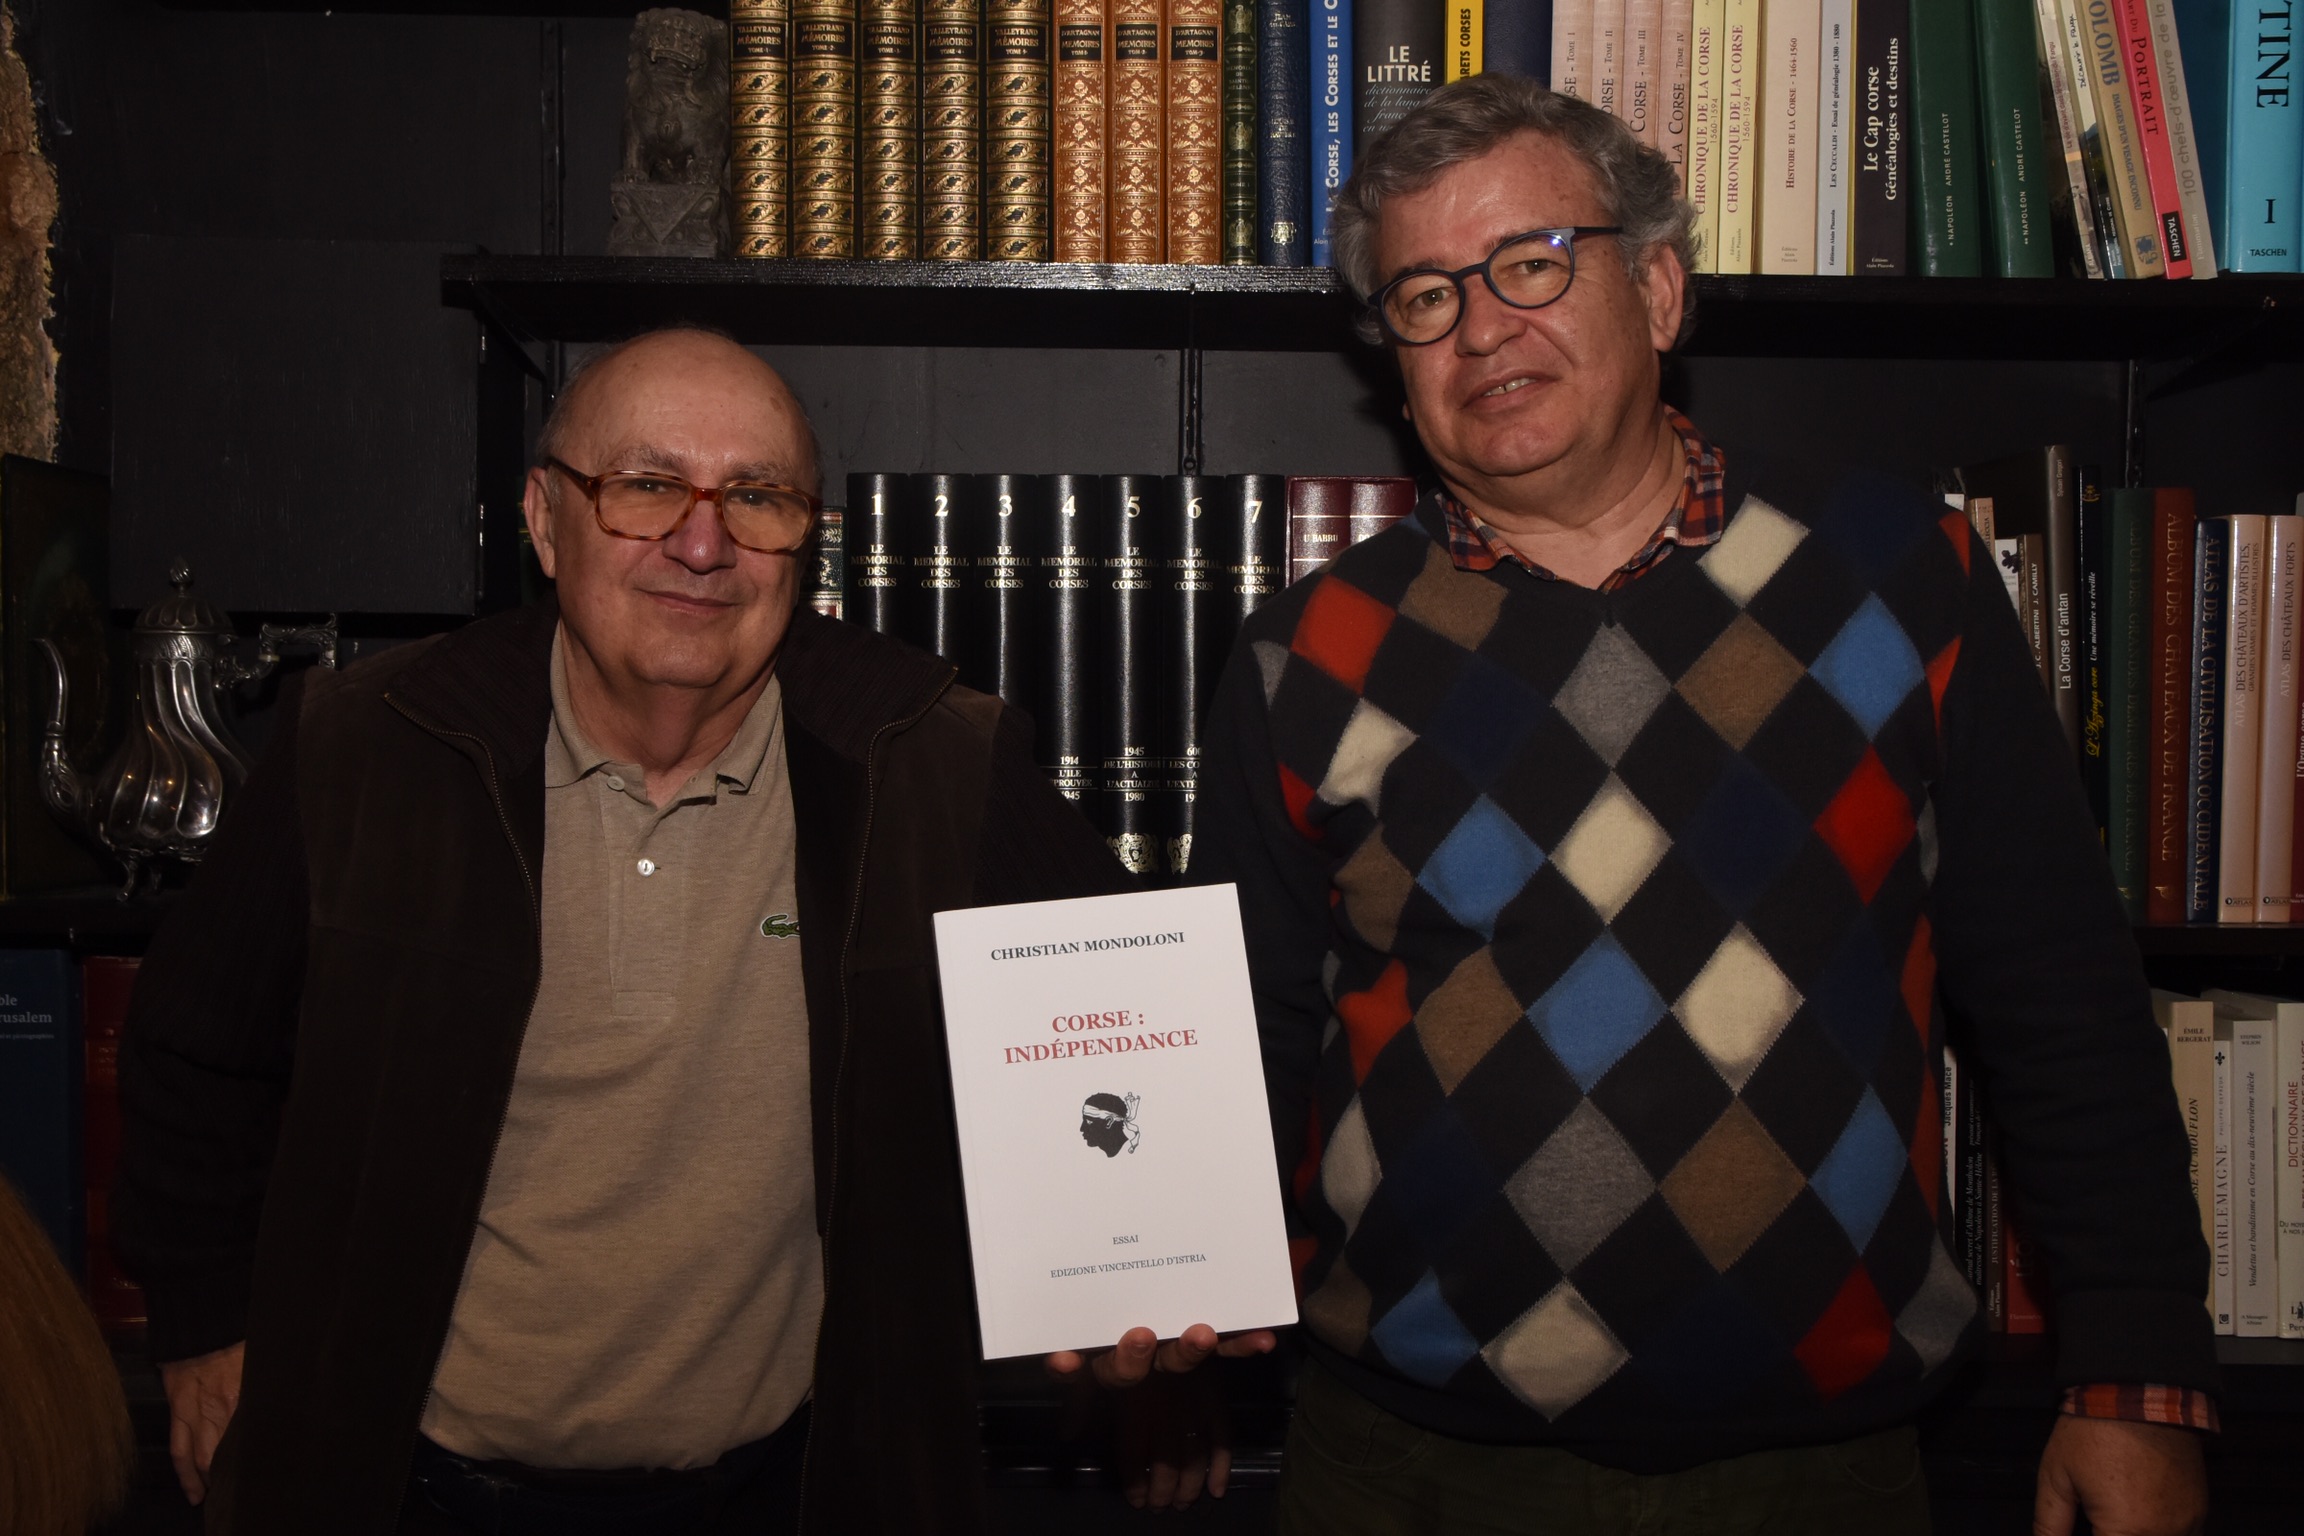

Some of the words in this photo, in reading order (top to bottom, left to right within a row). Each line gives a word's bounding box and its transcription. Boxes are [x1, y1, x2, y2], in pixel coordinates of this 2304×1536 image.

[1328, 16, 1338, 28] LE
[2155, 4, 2166, 18] la
[737, 26, 780, 34] TALLEYRAND
[802, 24, 844, 32] TALLEYRAND
[802, 33, 845, 43] MÉMOIRES
[930, 27, 972, 35] TALLEYRAND
[995, 27, 1038, 35] TALLEYRAND
[1460, 8, 1471, 47] CORSES
[2159, 24, 2170, 43] de
[737, 35, 781, 45] MÉMOIRES
[929, 36, 973, 46] MÉMOIRES
[995, 36, 1038, 46] MÉMOIRES
[1328, 35, 1338, 48] ET
[1731, 25, 1743, 74] CORSE
[2089, 0, 2120, 86] OLOMB
[1390, 46, 1410, 62] LE
[1698, 27, 1710, 76] CORSE
[2255, 0, 2293, 108] TINE
[1368, 60, 1431, 82] LITTRÉ
[1886, 38, 1898, 90] destins
[1325, 54, 1338, 106] CORSES
[1366, 84, 1431, 95] dictionnaire
[1668, 83, 1684, 134] CORSE
[1677, 32, 1684, 41] IV
[1698, 80, 1708, 99] LA
[1731, 78, 1741, 97] LA
[1832, 64, 1840, 99] généalogie
[1868, 66, 1879, 111] corse
[2132, 37, 2158, 135] PORTRAIT
[1364, 96, 1377, 108] de
[1380, 96, 1391, 107] la
[1630, 81, 1647, 132] CORSE
[1730, 101, 1741, 120] DE
[1787, 88, 1796, 117] CORSE
[1832, 101, 1838, 109] de
[1888, 94, 1897, 108] et
[2164, 49, 2189, 164] chefs-d'œuvre
[1328, 112, 1338, 132] LES
[1697, 103, 1708, 122] DE
[1710, 98, 1718, 143] 1560-1594
[1743, 96, 1751, 141] 1560-1594
[1789, 120, 1795, 130] LA
[1864, 116, 1883, 148] Cap
[1942, 113, 1950, 155] CASTELOT
[2014, 108, 2023, 151] CASTELOT
[1789, 133, 1795, 144] DE
[1325, 139, 1340, 188] CORSE,
[1864, 152, 1878, 171] Le
[1885, 112, 1900, 200] Généalogies
[1695, 126, 1709, 214] CHRONIQUE
[1727, 124, 1742, 213] CHRONIQUE
[1786, 148, 1795, 188] HISTOIRE
[2016, 154, 2024, 182] ANDRÉ
[2181, 169, 2196, 196] 100
[1946, 195, 1954, 240] NAPOLÉON
[2020, 191, 2029, 236] NAPOLÉON
[2264, 198, 2276, 224] I
[2168, 217, 2181, 257] TASCHEN
[2250, 248, 2287, 257] TASCHEN
[872, 493, 884, 515] 1
[935, 495, 949, 516] 2
[999, 495, 1012, 516] 3
[1062, 496, 1076, 517] 4
[1127, 496, 1140, 518] 5
[1187, 497, 1202, 519] 6
[1247, 500, 1263, 523] 7
[870, 544, 884, 554] LE
[1312, 534, 1338, 543] BABBU
[2167, 512, 2184, 582] ALBUM
[851, 556, 905, 565] MEMORIAL
[914, 557, 969, 566] MEMORIAL
[934, 546, 948, 555] LE
[977, 557, 1032, 566] MEMORIAL
[997, 546, 1011, 555] LE
[1062, 546, 1076, 555] LE
[1126, 547, 1139, 556] LE
[1188, 548, 1202, 557] LE
[1247, 556, 1261, 565] LE
[2286, 542, 2295, 576] FORTS
[867, 567, 887, 575] DES
[931, 568, 951, 577] DES
[994, 568, 1014, 577] DES
[1041, 558, 1097, 567] MEMORIAL
[1058, 569, 1079, 577] DES
[1122, 569, 1142, 578] DES
[2204, 535, 2220, 592] ATLAS
[858, 578, 897, 587] CORSES
[921, 580, 960, 588] CORSES
[985, 580, 1024, 588] CORSES
[1049, 580, 1088, 588] CORSES
[1184, 571, 1204, 580] DES
[1244, 576, 1264, 585] DES
[2088, 571, 2096, 599] réveille
[2239, 543, 2252, 605] D'ARTISTES,
[1112, 581, 1152, 590] CORSES
[1174, 582, 1213, 590] CORSES
[1234, 585, 1274, 594] CORSES
[2058, 593, 2070, 637] d'antan
[2092, 600, 2096, 609] se
[2166, 591, 2182, 626] DES
[2202, 597, 2218, 622] DE
[2281, 580, 2295, 638] CHÂTEAUX
[2032, 609, 2041, 649] ALBERTINI
[2089, 611, 2097, 644] mémoire
[2237, 610, 2248, 667] CHÂTEAUX
[2201, 627, 2217, 651] LA
[2059, 640, 2071, 672] Corse
[2282, 640, 2292, 662] DES
[2060, 675, 2071, 689] La
[2236, 669, 2246, 691] DES
[2197, 656, 2217, 781] CIVILISATION
[1060, 756, 1079, 765] 1914
[1124, 747, 1144, 756] 1945
[2163, 751, 2179, 776] DE
[1124, 792, 1145, 802] 1980
[2162, 783, 2178, 861] FRANCE
[2194, 784, 2213, 911] OCCIDENTALE
[991, 942, 1080, 960] CHRISTIAN
[1084, 932, 1185, 952] MONDOLONI
[1052, 1010, 1132, 1033] CORSE
[1004, 1029, 1198, 1064] INDÉPENDANCE
[2246, 1072, 2254, 1094] siècle
[2188, 1098, 2198, 1158] MOUFLON
[2247, 1096, 2255, 1146] dix-neuvième
[2288, 1081, 2298, 1167] DICTIONNAIRE
[2250, 1150, 2255, 1160] au
[2251, 1187, 2256, 1197] en
[2216, 1144, 2229, 1277] CHARLEMAGNE
[2248, 1201, 2256, 1244] banditisme
[1113, 1235, 1139, 1245] ESSAI
[1050, 1265, 1097, 1278] EDIZIONE
[1099, 1258, 1164, 1272] VINCENTELLO
[1166, 1254, 1206, 1266] D'ISTRIA
[2249, 1257, 2257, 1287] Vendetta
